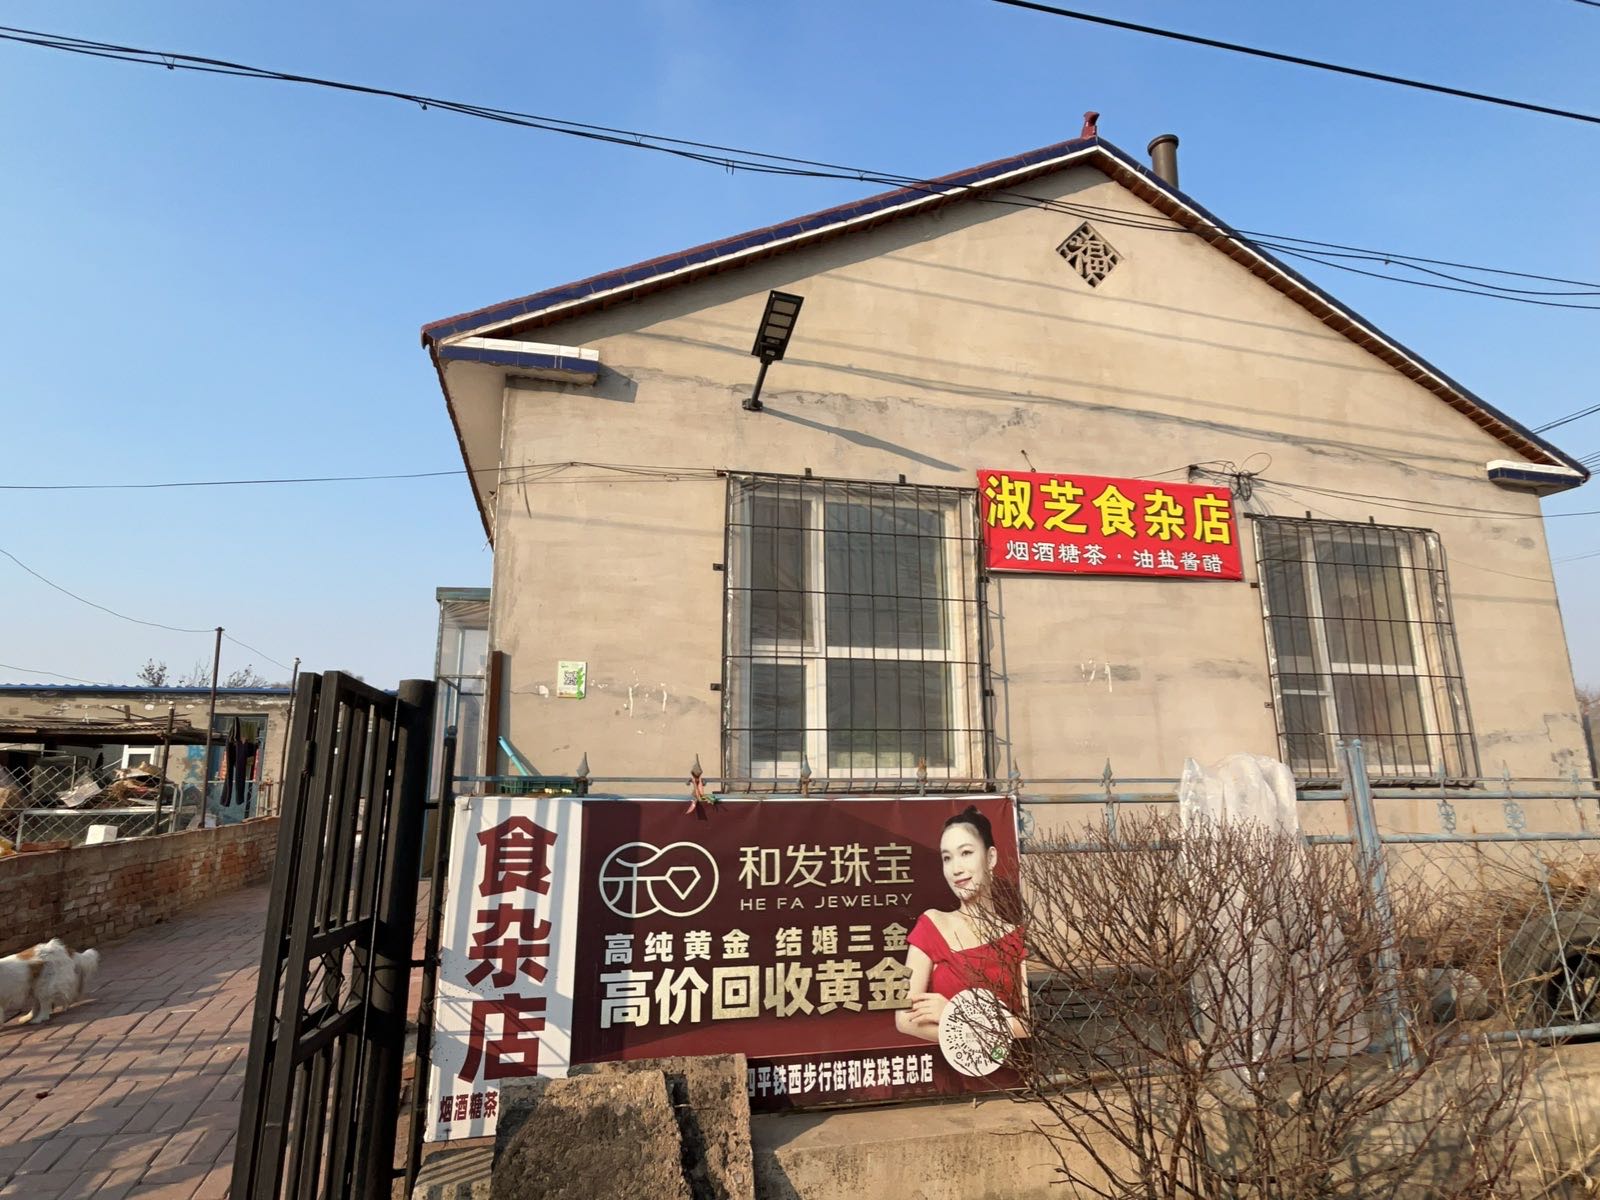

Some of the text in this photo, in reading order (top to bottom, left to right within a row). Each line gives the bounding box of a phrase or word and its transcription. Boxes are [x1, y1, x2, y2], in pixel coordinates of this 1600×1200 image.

[985, 475, 1232, 545] 淑芝食杂店
[738, 842, 915, 890] 和发珠宝
[740, 893, 913, 911] HE FA JEWELRY
[457, 815, 559, 1084] 食杂店
[604, 922, 908, 965] 高纯黄金 结婚三金
[600, 956, 914, 1029] 高价回收黄金
[438, 1090, 499, 1123] 烟酒糖茶
